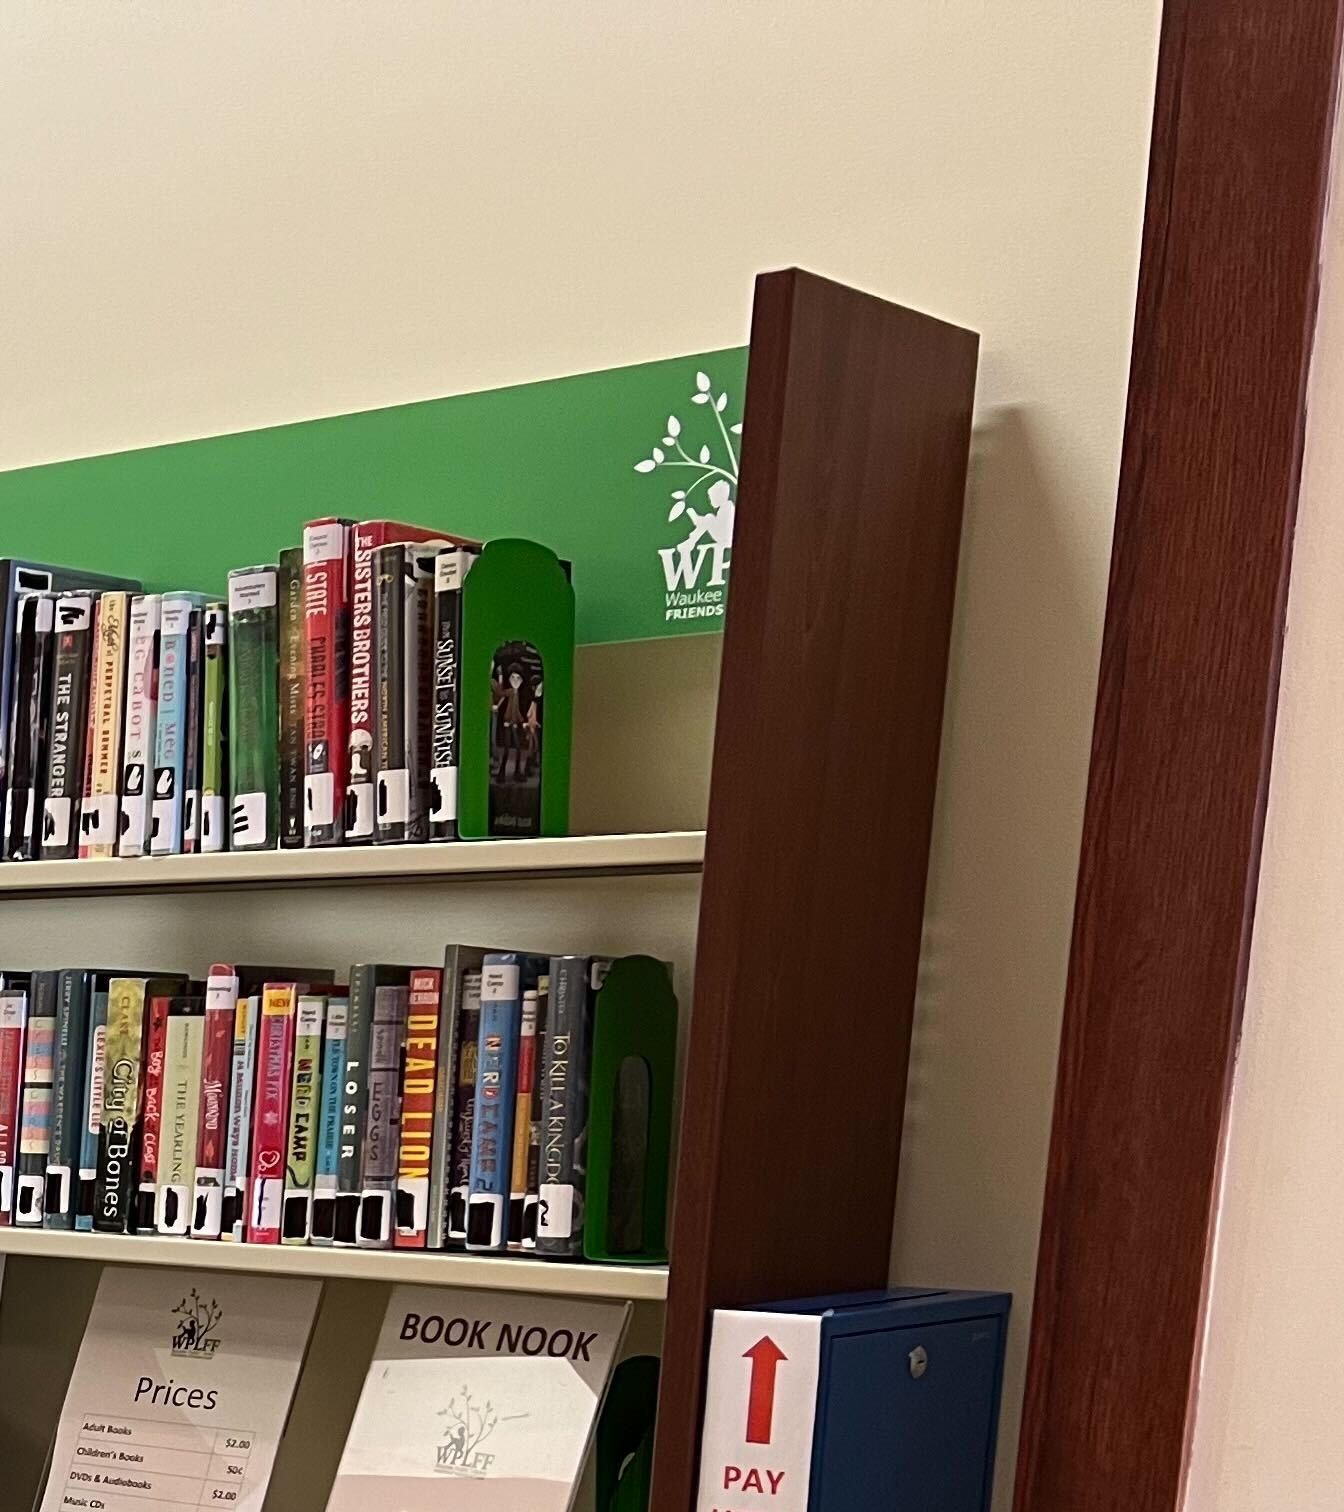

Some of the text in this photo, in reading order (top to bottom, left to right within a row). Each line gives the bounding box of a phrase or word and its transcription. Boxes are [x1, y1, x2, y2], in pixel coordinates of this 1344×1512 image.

[665, 590, 722, 606] Waukee
[666, 604, 724, 620] FRIENDS
[350, 550, 371, 724] SISTERS BROTHERS
[50, 674, 72, 797] THE STRANGER
[91, 1031, 106, 1128] LEXIE'S LITTLE LIE
[266, 1017, 283, 1099] CHRISTMAS FIX
[548, 1033, 571, 1111] TO KILL A
[342, 1061, 360, 1158] LOSER
[399, 1014, 438, 1179] DEAD LION
[103, 1059, 133, 1217] City of Bones
[171, 1081, 187, 1182] THE YEARLING
[292, 1112, 309, 1161] CAMP
[369, 1081, 384, 1161] EGGS
[172, 1336, 220, 1352] WPLFF
[400, 1313, 597, 1361] BOOK NOOK
[135, 1377, 218, 1410] Prices
[83, 1423, 250, 1450] Adult Books $2.00
[119, 1452, 143, 1463] Books
[436, 1446, 495, 1470] WPLFF
[64, 1496, 87, 1508] Music
[70, 1472, 92, 1483] DVDs
[103, 1475, 152, 1490] Audiobooks
[213, 1489, 236, 1501] $2.00
[723, 1466, 785, 1495] PAY
